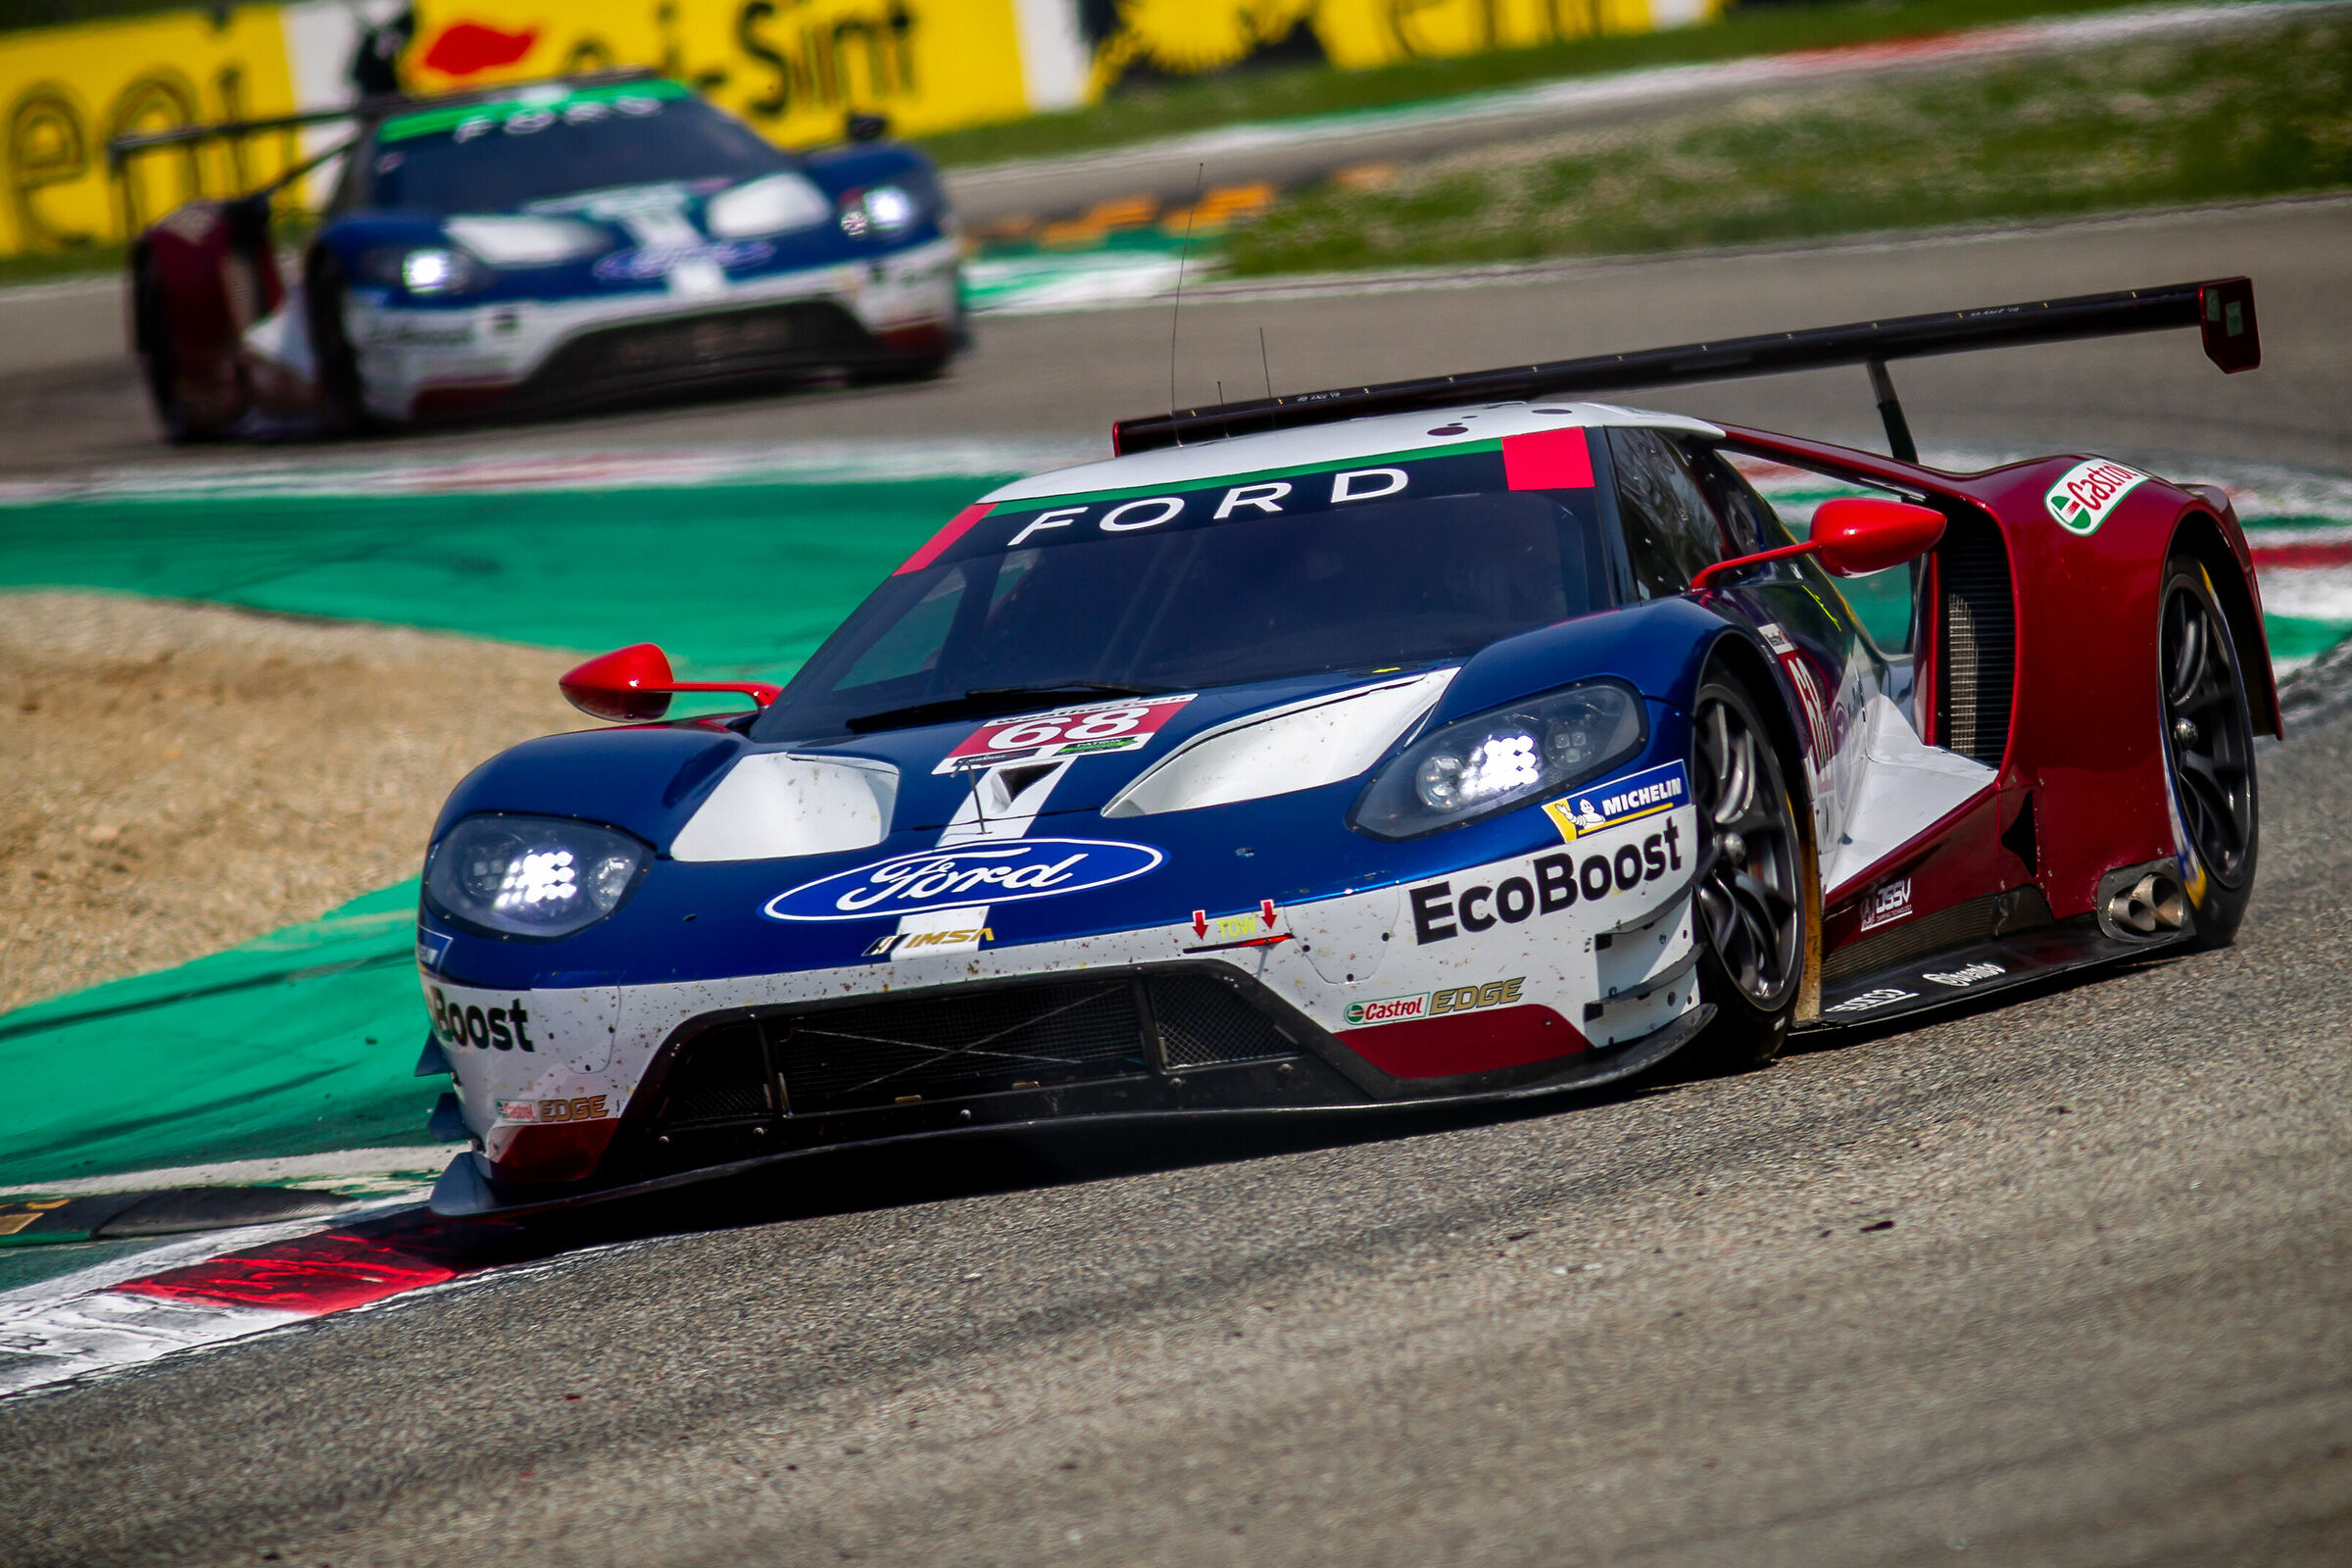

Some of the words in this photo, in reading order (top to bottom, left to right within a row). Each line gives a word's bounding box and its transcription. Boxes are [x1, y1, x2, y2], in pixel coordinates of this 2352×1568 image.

[1007, 467, 1409, 547] FORD
[2066, 461, 2139, 511] Castrol
[988, 708, 1151, 750] 68
[1600, 777, 1682, 817] MICHELIN
[836, 847, 1090, 911] Ford
[1409, 816, 1683, 946] EcoBoost
[905, 928, 995, 949] IMSA
[1216, 916, 1259, 939] TOW
[1365, 997, 1423, 1021] Castrol
[1429, 976, 1527, 1016] EDGE
[538, 1094, 610, 1122] EDGE
